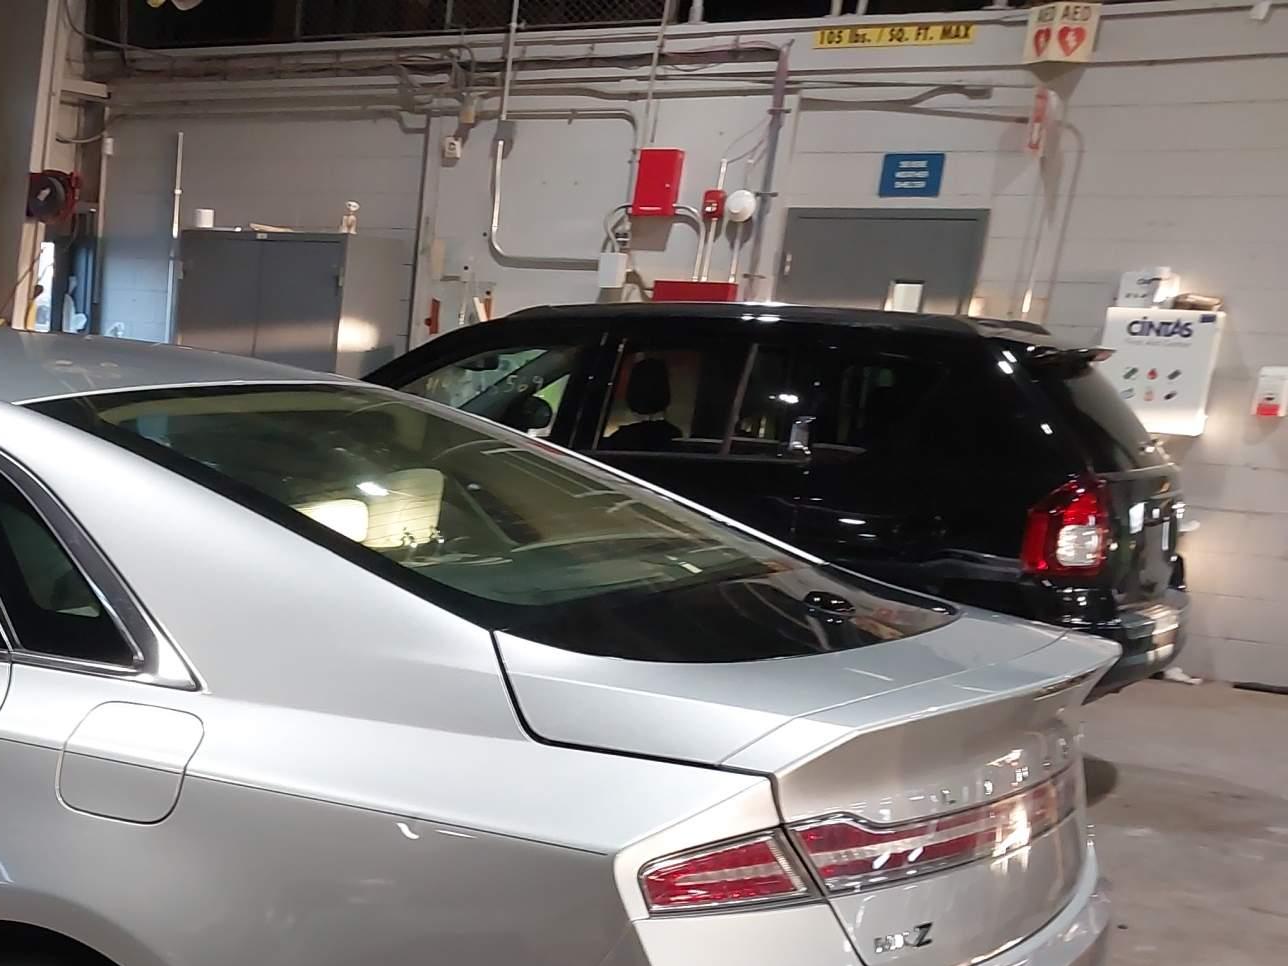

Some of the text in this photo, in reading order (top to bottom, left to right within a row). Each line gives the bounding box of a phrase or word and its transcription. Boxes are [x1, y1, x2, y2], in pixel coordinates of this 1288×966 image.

[1062, 5, 1091, 21] AED
[819, 29, 843, 44] 105
[888, 27, 909, 42] SQ.
[914, 25, 934, 41] FT.
[940, 23, 971, 40] MAX
